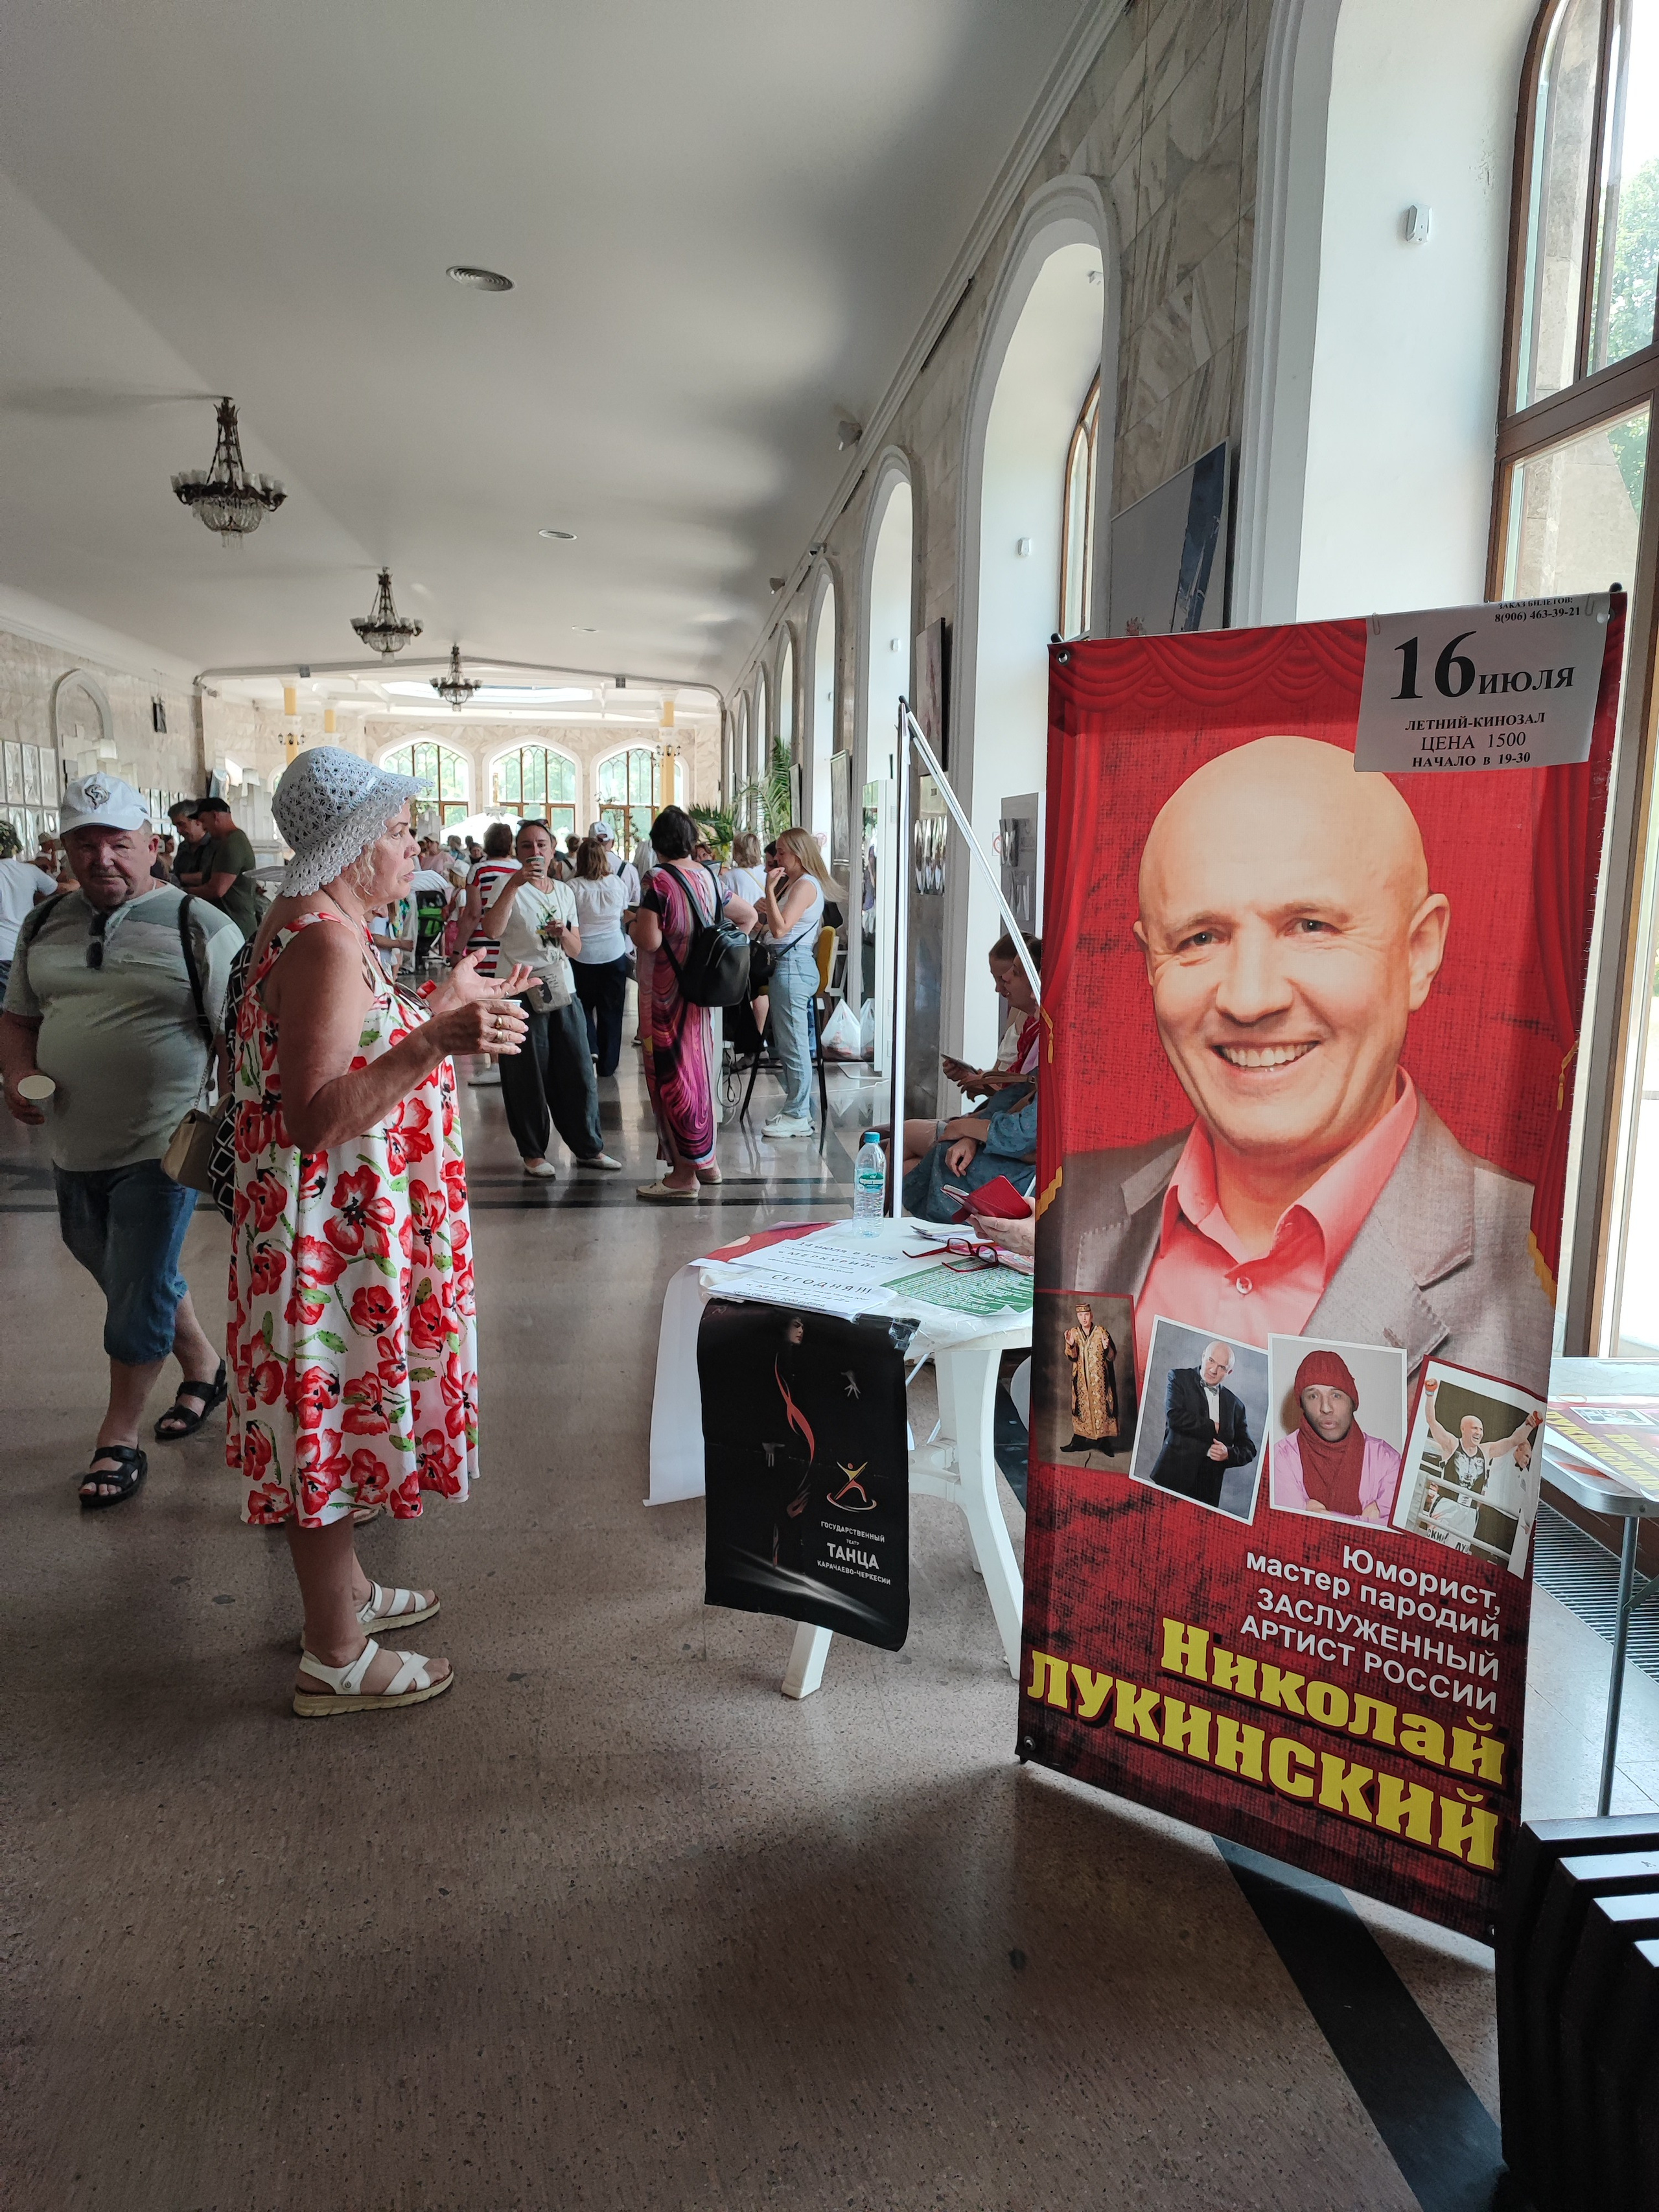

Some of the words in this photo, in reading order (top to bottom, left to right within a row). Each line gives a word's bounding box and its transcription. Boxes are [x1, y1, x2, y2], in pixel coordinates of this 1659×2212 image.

[1495, 611, 1527, 623] 8(906)
[1530, 606, 1580, 620] 463-39-21
[1498, 601, 1526, 609] ЗАКАЗ
[1391, 631, 1477, 699] 16
[1405, 712, 1546, 731] ЛЕТНИЙ-КИНОЗАЛ
[1421, 735, 1475, 753] ЦЕНА
[1488, 732, 1526, 748] 1500
[1412, 756, 1476, 767] НАЧАЛО
[1498, 751, 1531, 765] 19-30
[820, 1520, 885, 1543] ГОСУДАРСТВЕННЫЙ
[827, 1543, 879, 1569] ТАНЦА
[817, 1559, 891, 1585] КАРАЧАЕВО-ЧЕРКЕСИИ
[1343, 1544, 1501, 1617] Юморист,
[1246, 1552, 1351, 1600] мастер
[1360, 1584, 1500, 1642] пародий
[1257, 1588, 1500, 1682] ЗАСЛУЖЕННЫЙ
[1240, 1614, 1356, 1667] АРТИСТ
[1364, 1651, 1497, 1716] РОССИИ
